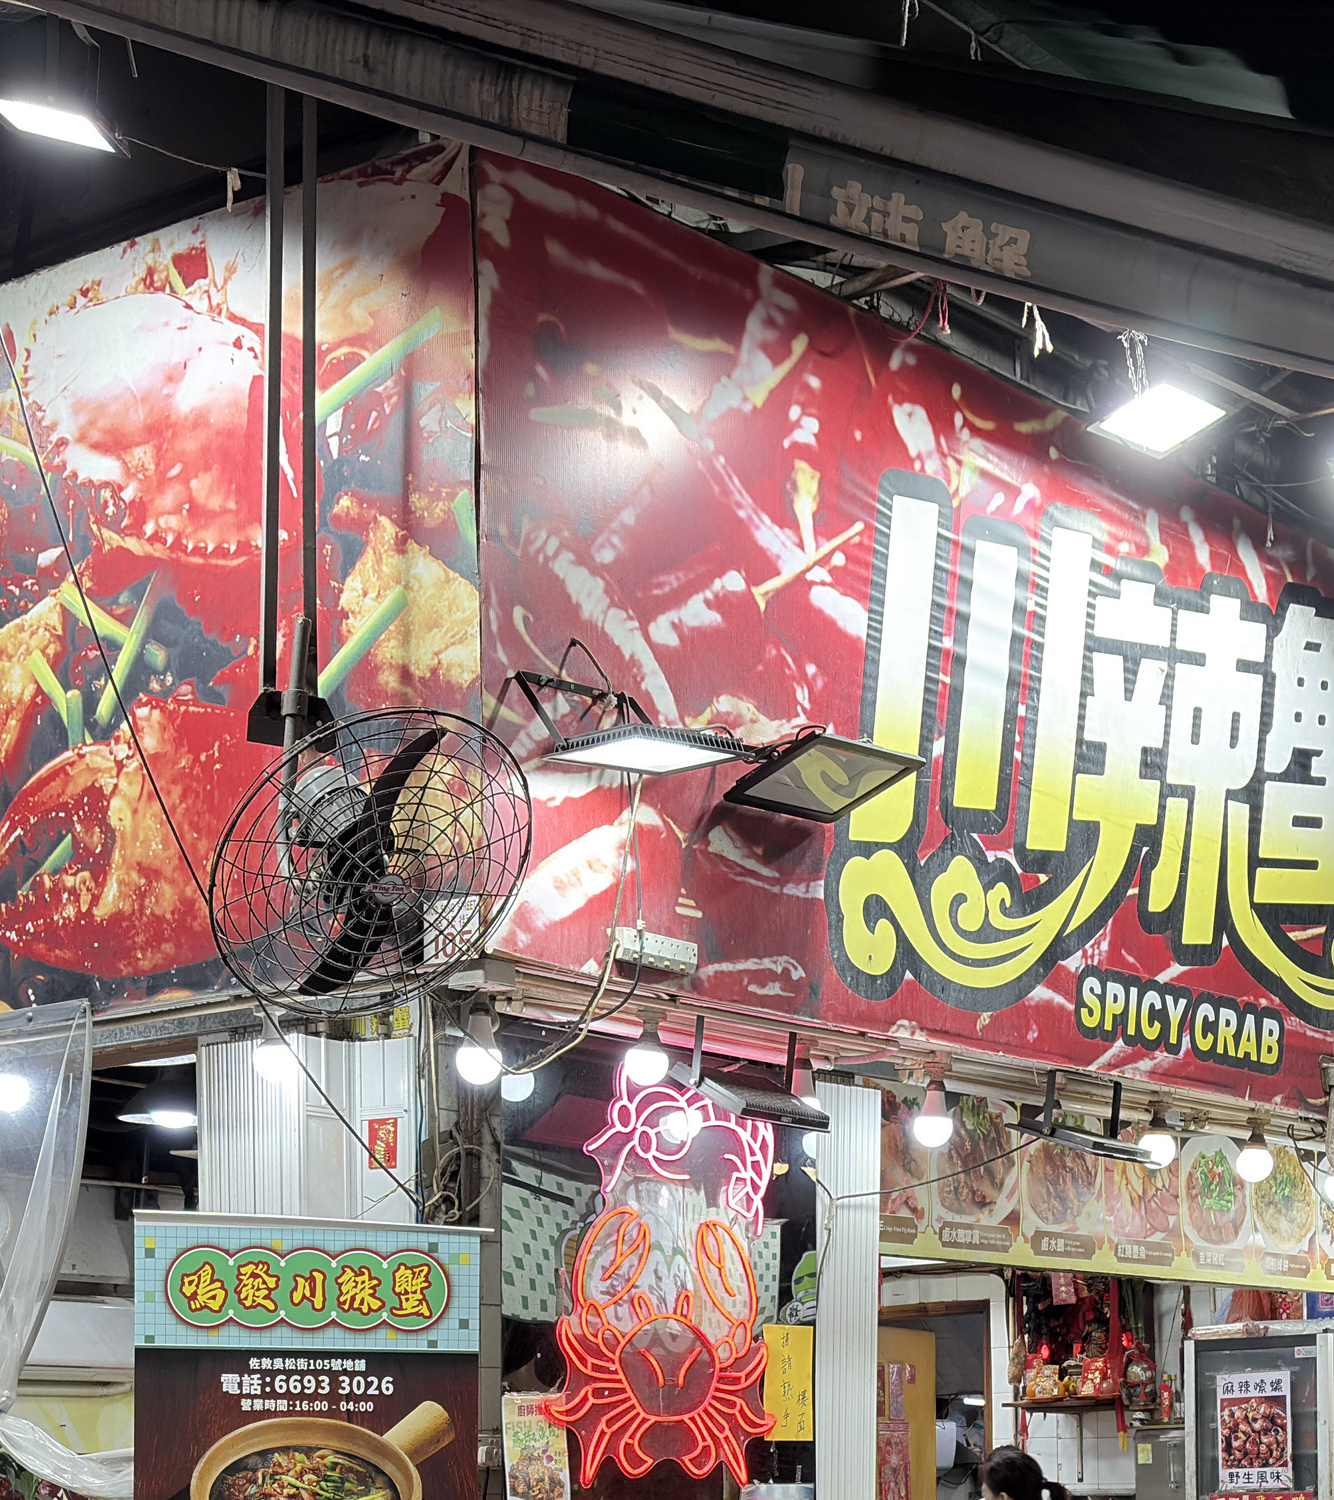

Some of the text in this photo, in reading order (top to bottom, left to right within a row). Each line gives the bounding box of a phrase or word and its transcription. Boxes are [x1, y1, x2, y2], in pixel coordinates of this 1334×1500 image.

[1079, 977, 1281, 1065] SPICY CRAB
[181, 1261, 433, 1318] 鳴發川辣蟹
[338, 1376, 394, 1396] 3026
[339, 1400, 374, 1413] 04:00
[1228, 1470, 1283, 1485] 野生風味
